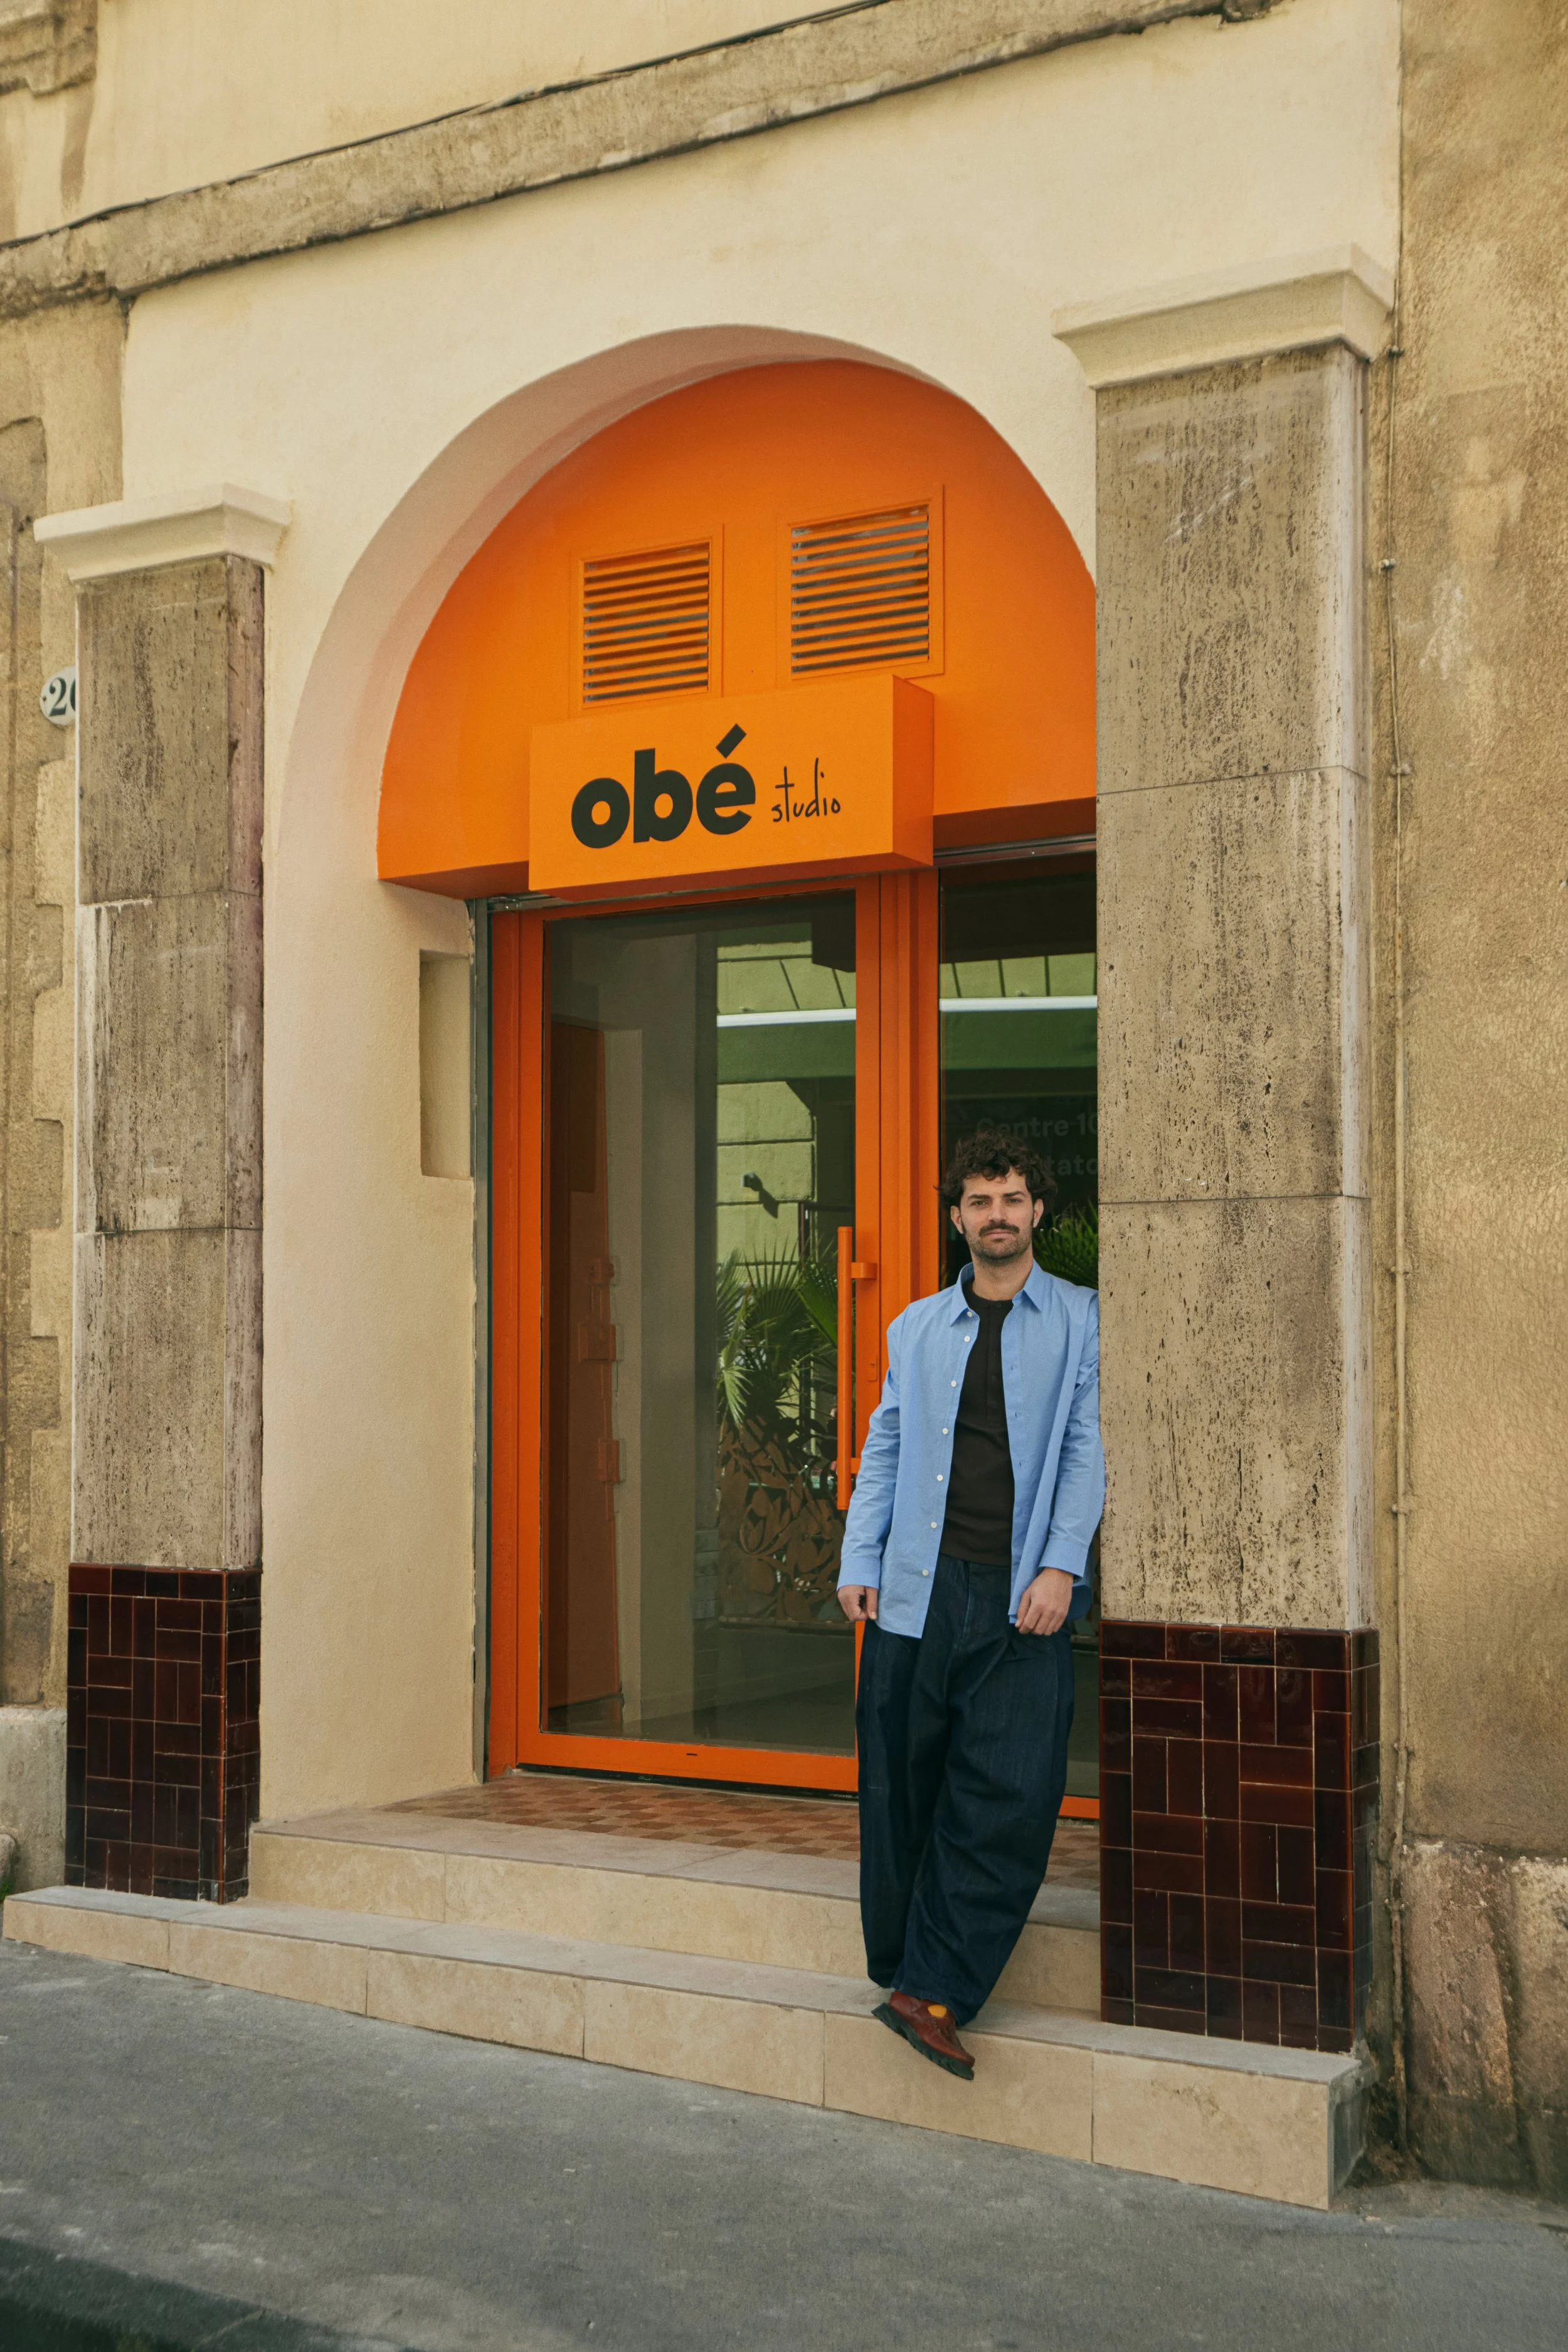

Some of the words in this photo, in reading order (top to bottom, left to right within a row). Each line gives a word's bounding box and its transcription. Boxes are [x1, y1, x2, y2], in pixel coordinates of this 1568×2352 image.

[571, 723, 756, 849] obé
[771, 758, 841, 822] studio
[976, 1116, 1069, 1136] Centre
